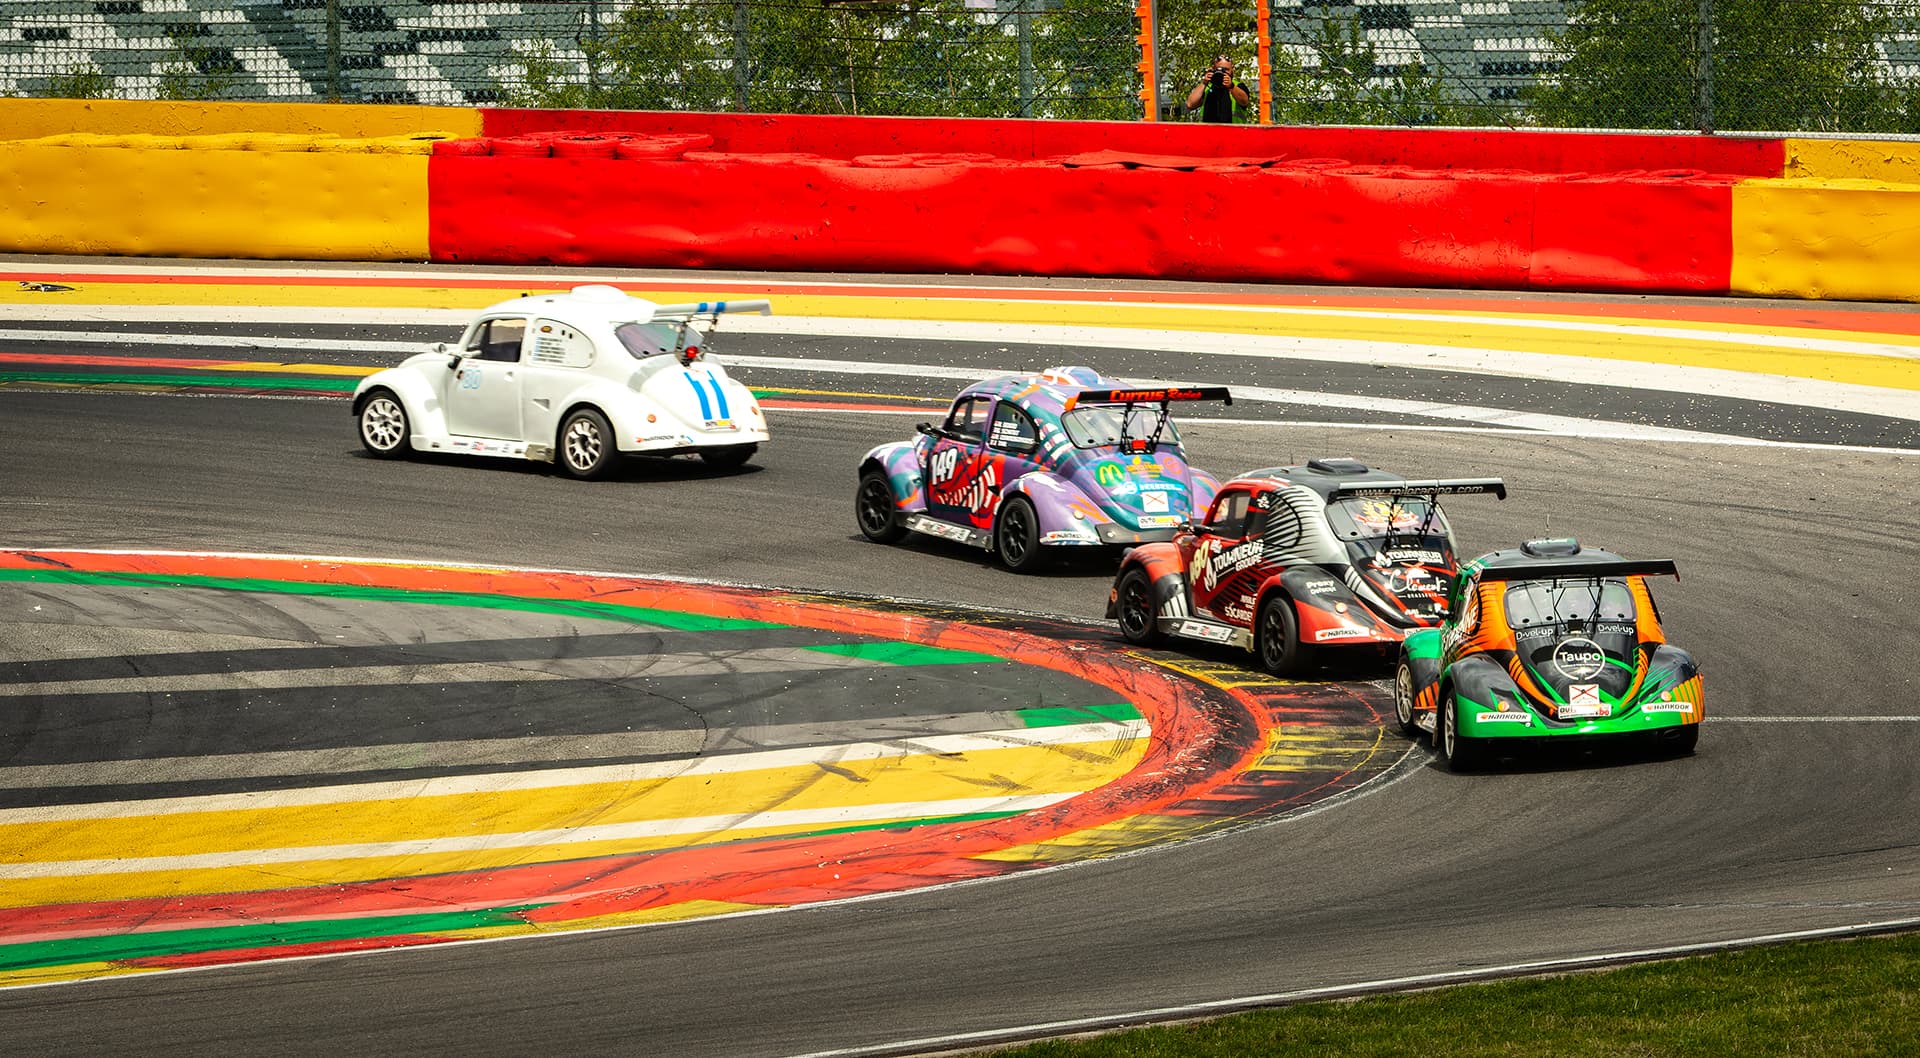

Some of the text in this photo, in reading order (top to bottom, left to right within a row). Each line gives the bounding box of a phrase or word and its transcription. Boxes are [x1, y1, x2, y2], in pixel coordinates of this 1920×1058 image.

[931, 446, 958, 486] 149
[1386, 550, 1443, 561] TOURNEUR
[1559, 651, 1601, 664] Taupo
